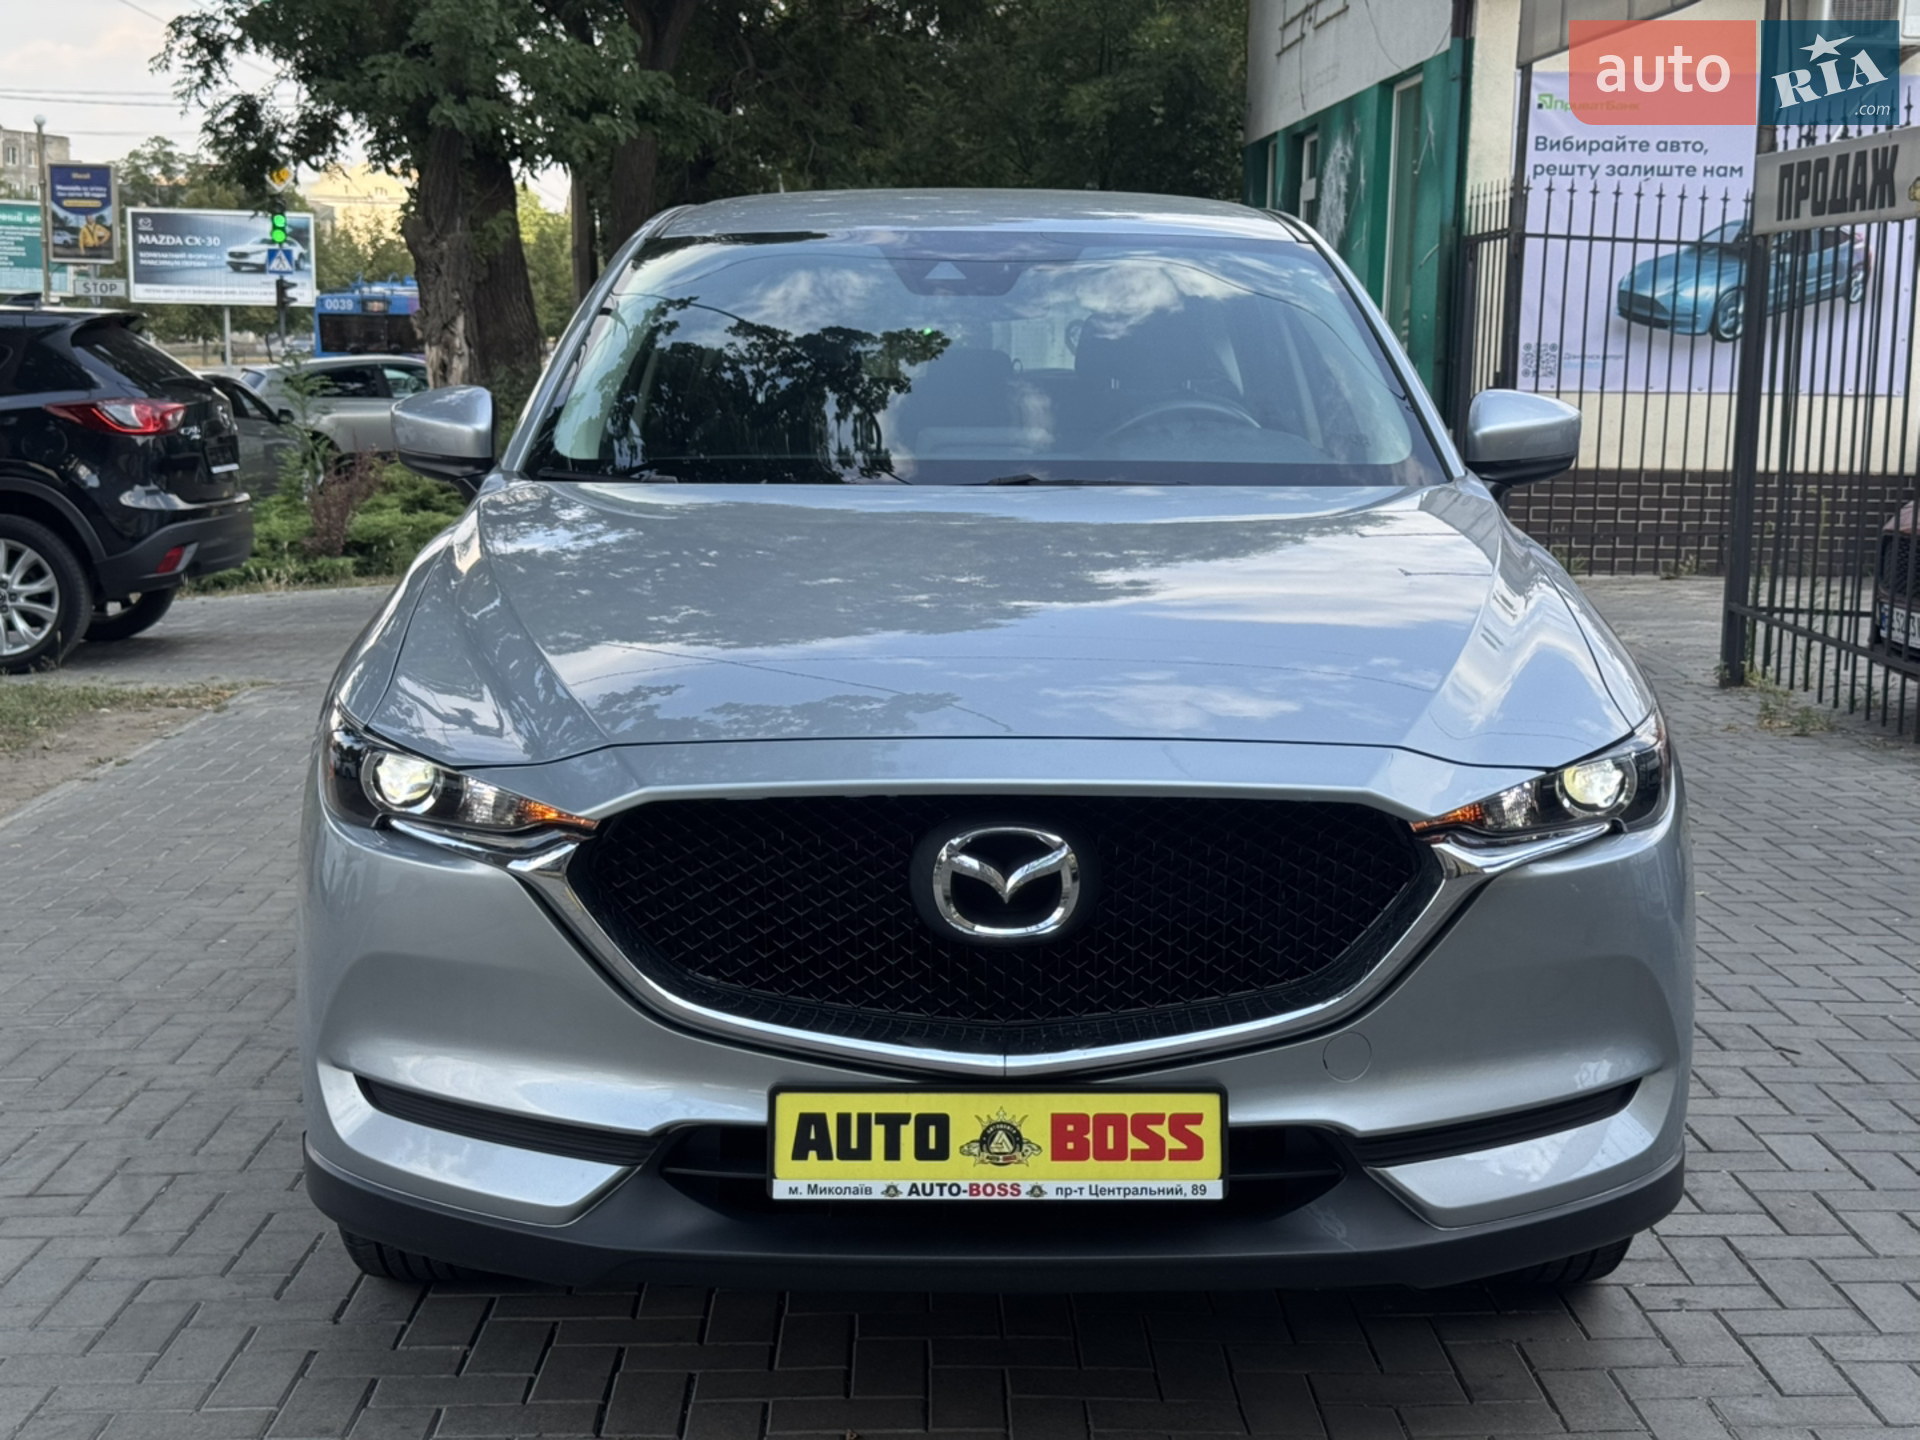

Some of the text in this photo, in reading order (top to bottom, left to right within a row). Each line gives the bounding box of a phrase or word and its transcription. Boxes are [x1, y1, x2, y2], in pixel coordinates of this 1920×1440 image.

[1534, 135, 1709, 156] Вибирайте авто,
[1533, 163, 1743, 180] решту залиште нам
[1776, 144, 1899, 222] ПРОДАЖ
[138, 234, 221, 247] MAZDA CX-30
[83, 282, 118, 294] STOP
[325, 298, 354, 310] 0039
[791, 1112, 1204, 1161] AUTO BOSS
[788, 1182, 1207, 1198] м. Миколаїв AUTO-BOSS пр-т Центральний, 89
